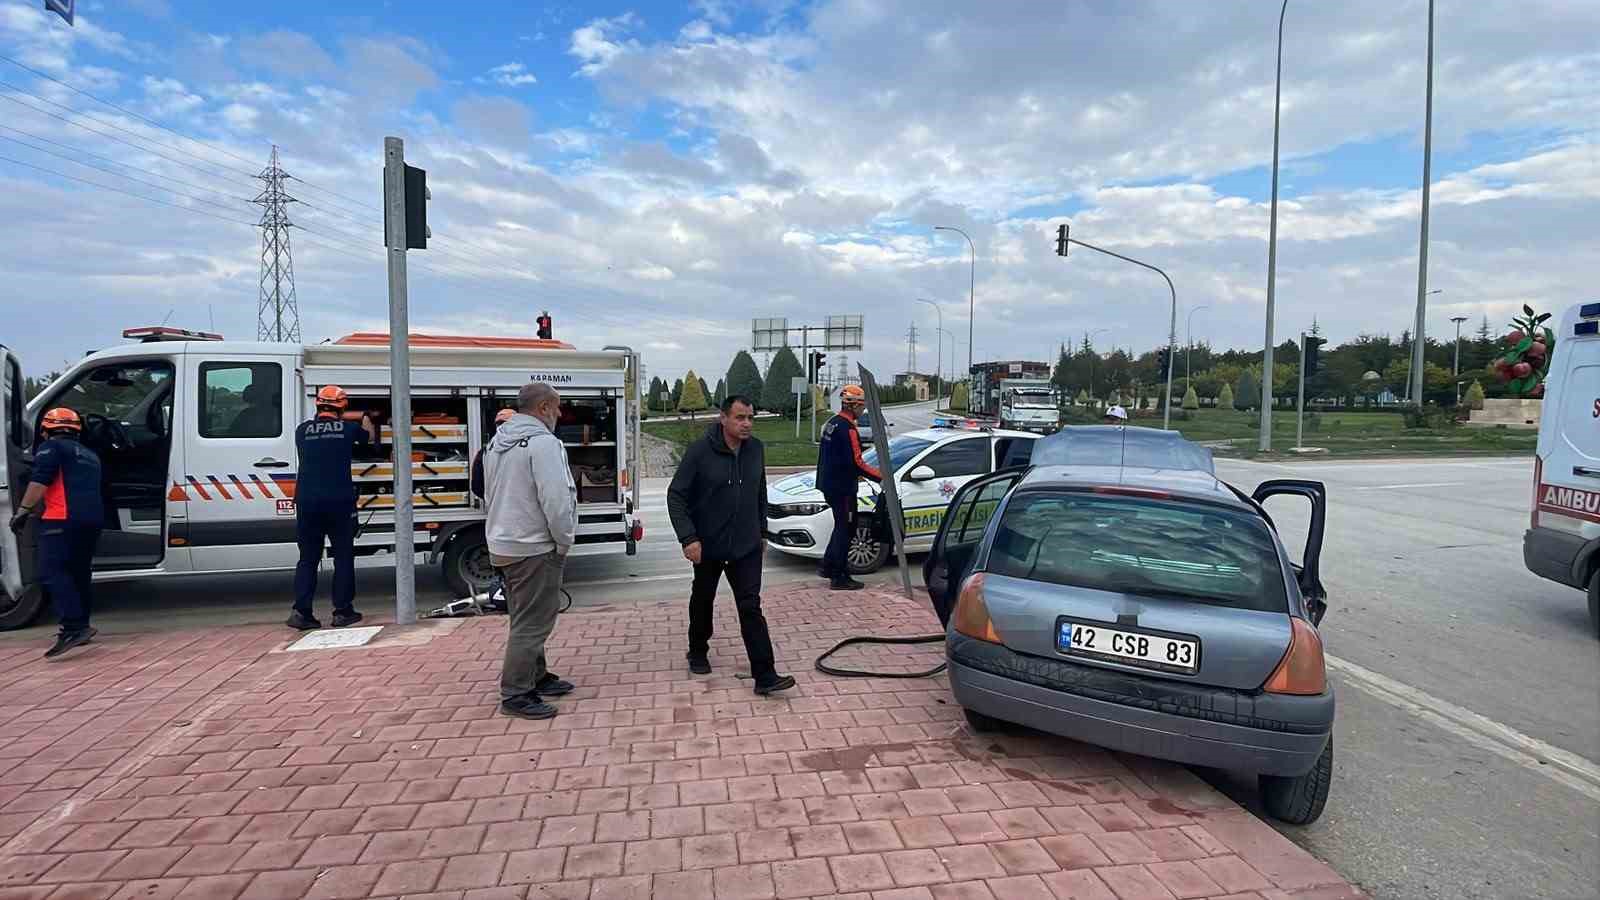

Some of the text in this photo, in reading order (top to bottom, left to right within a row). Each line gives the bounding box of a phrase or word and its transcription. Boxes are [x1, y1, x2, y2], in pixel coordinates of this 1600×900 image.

[530, 374, 572, 382] KARAMAN
[305, 421, 344, 434] AFAD
[278, 500, 293, 509] 112
[1544, 486, 1600, 512] AMBU
[904, 510, 944, 529] TRAFİ
[1072, 627, 1096, 649] 42
[1112, 633, 1149, 657] CSB
[1166, 641, 1192, 663] 83
